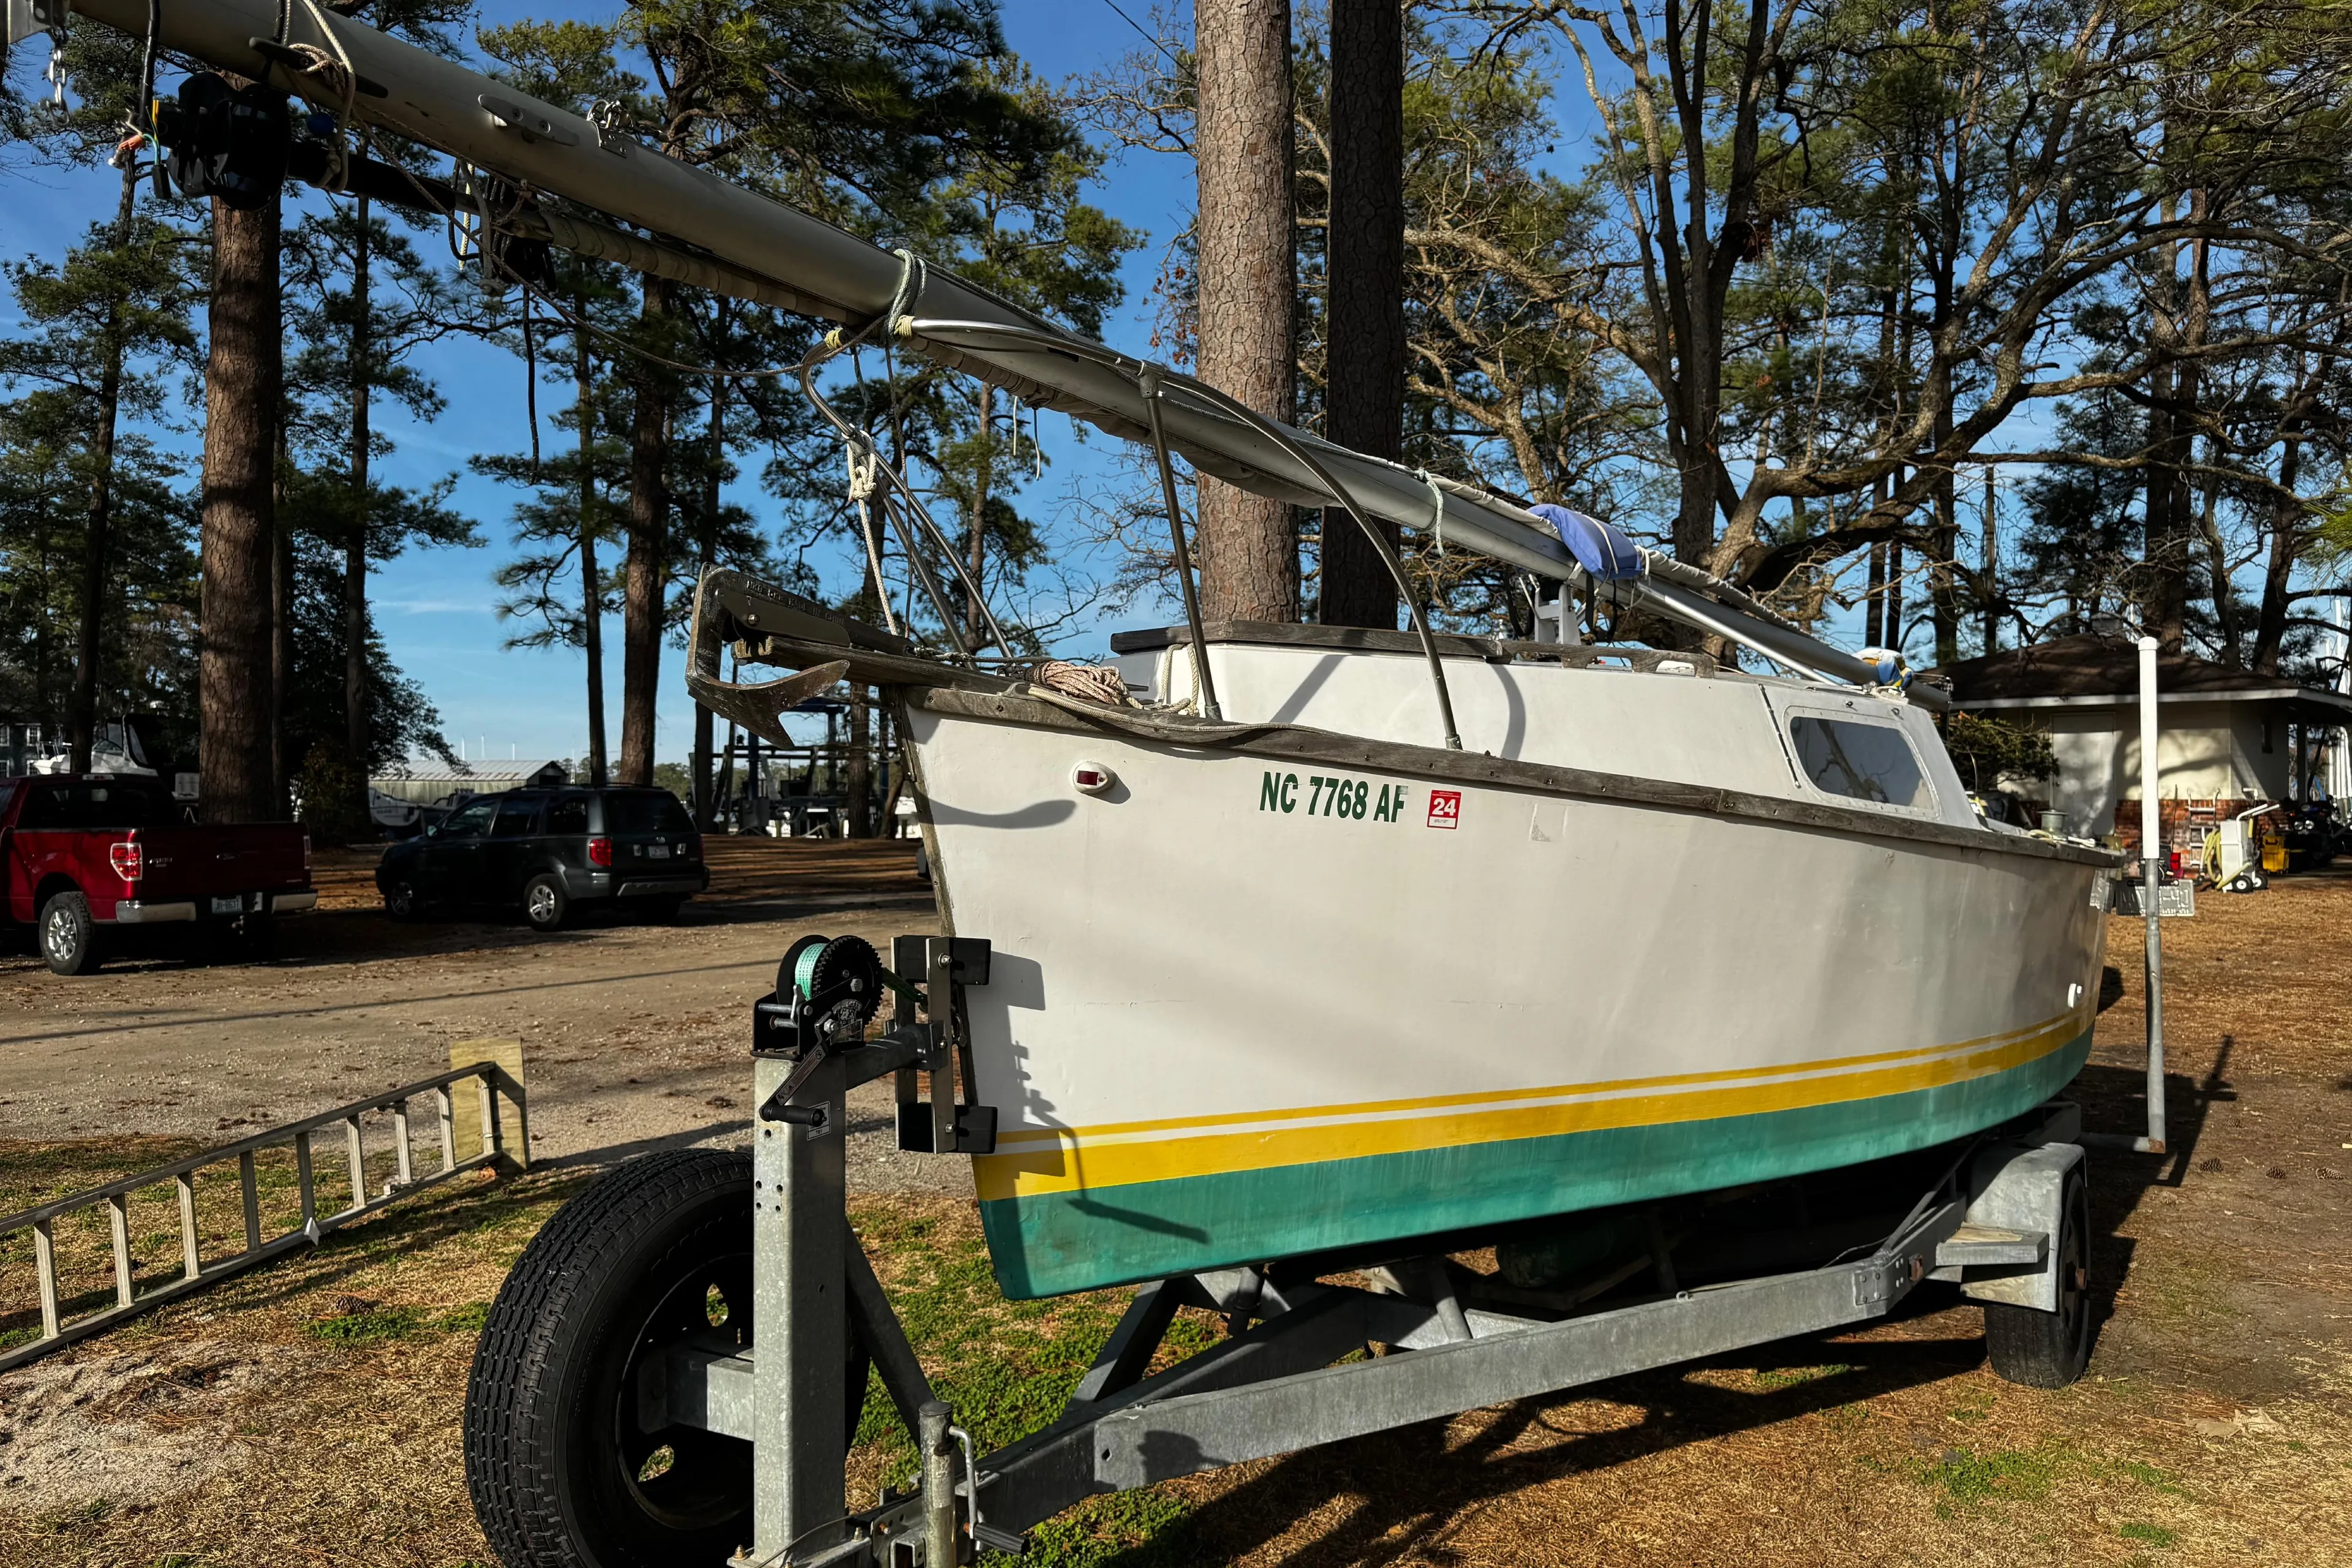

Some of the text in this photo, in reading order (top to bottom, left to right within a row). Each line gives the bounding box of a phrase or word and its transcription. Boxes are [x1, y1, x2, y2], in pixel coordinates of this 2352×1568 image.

[1259, 771, 1408, 823] NC 7768 AF
[1431, 797, 1457, 816] 24
